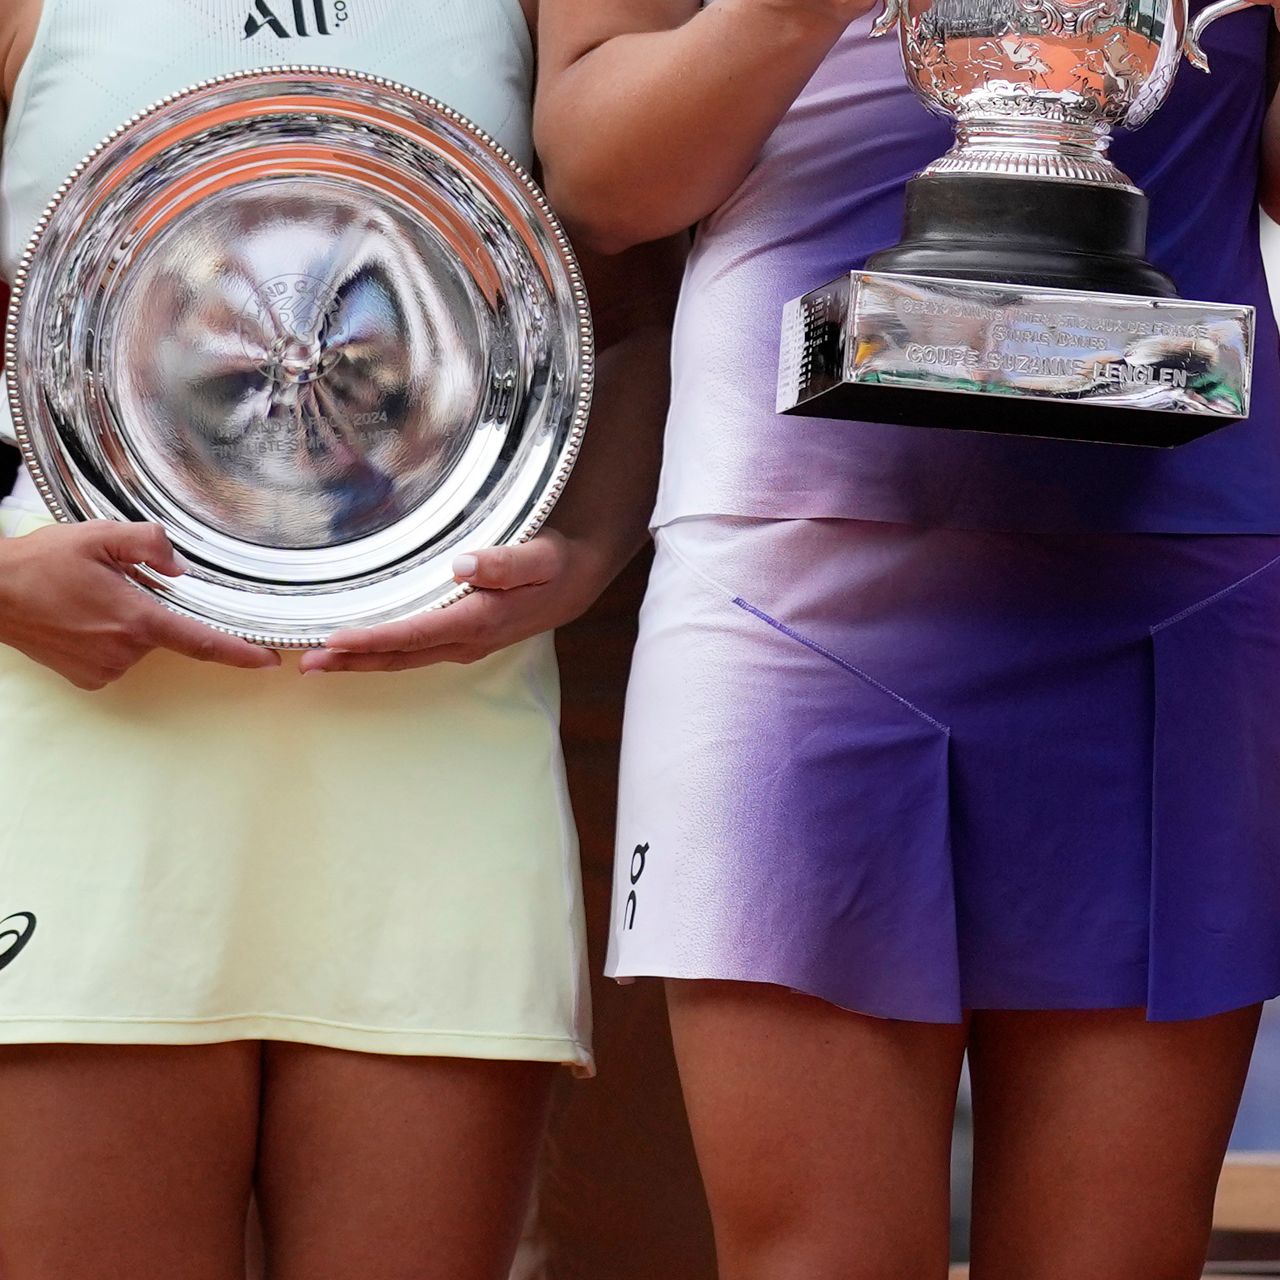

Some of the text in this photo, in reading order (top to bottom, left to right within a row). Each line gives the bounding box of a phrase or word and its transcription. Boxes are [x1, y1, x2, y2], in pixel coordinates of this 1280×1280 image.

[905, 343, 1188, 388] COUPE SUZANNE LENGLEN
[354, 412, 389, 426] 2024
